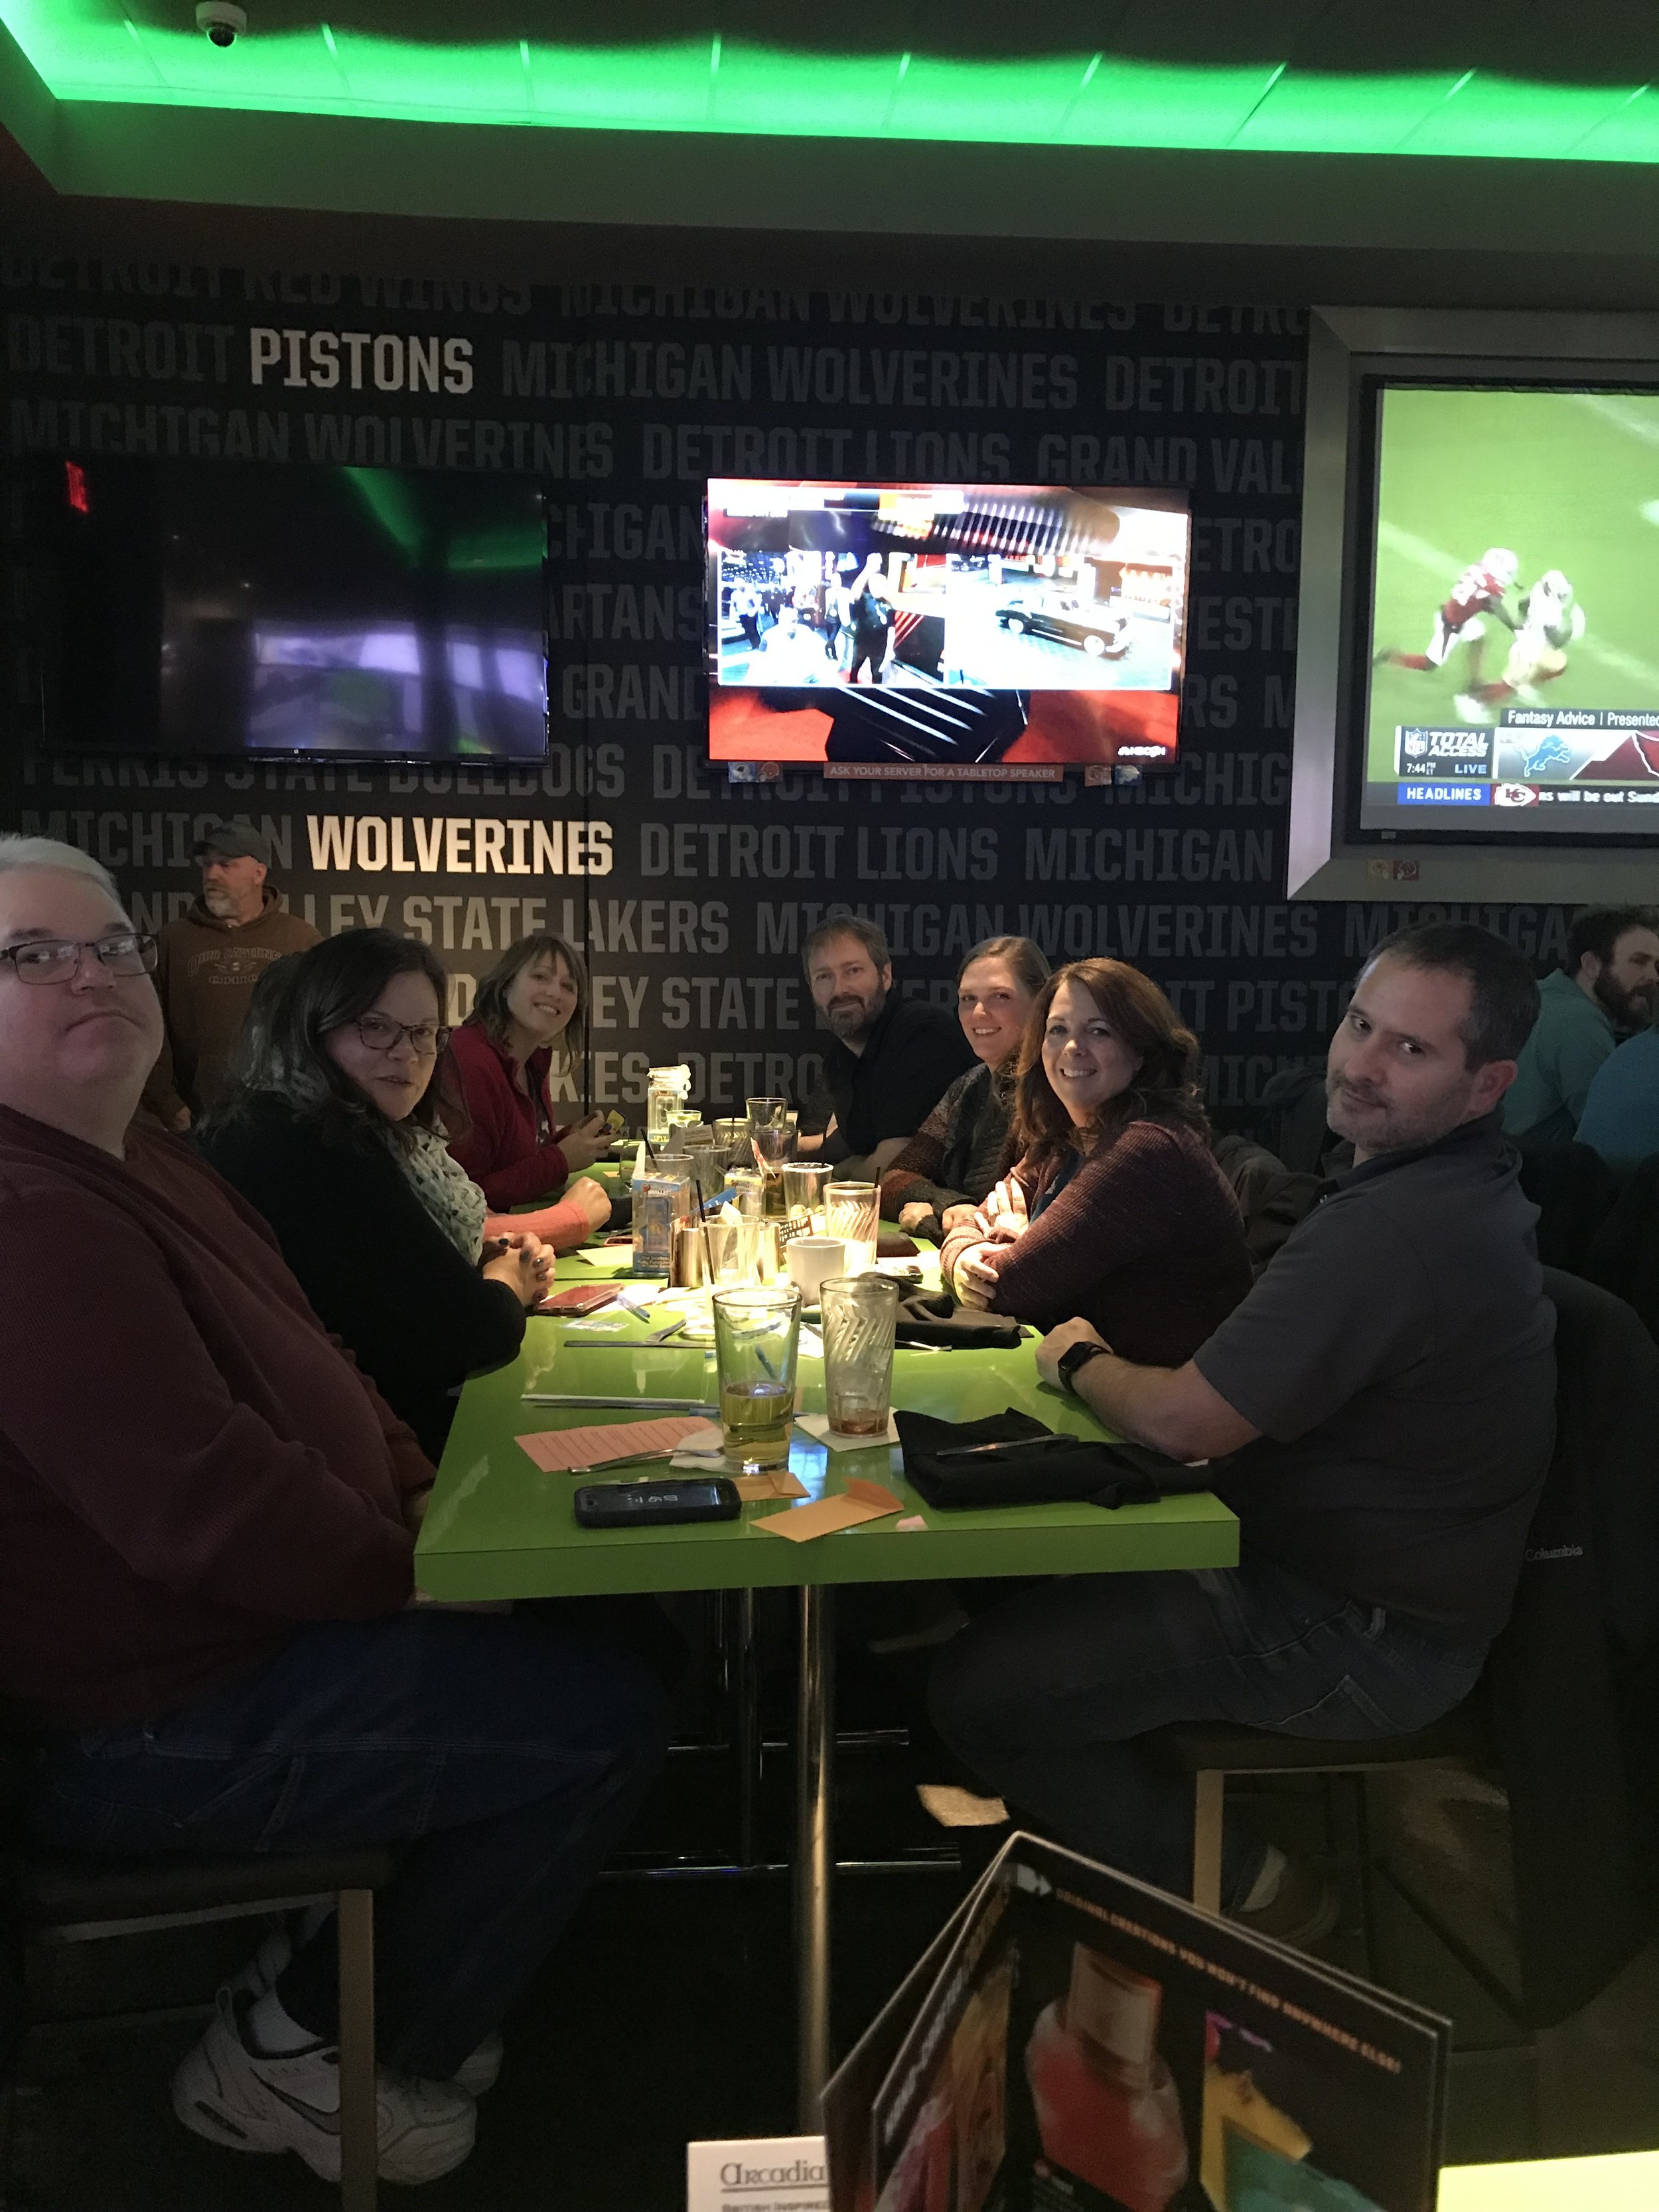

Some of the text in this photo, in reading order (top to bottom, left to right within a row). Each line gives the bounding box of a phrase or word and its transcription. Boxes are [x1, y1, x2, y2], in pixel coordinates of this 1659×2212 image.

[7, 311, 235, 384] DETROIT
[249, 327, 474, 395] PISTONS
[502, 339, 753, 400] MICHIGAN
[766, 345, 1080, 411] WOLVERINES
[11, 400, 289, 462] MICHIGAN
[304, 413, 614, 479] WOLVERINES
[642, 423, 853, 480] DETROIT
[865, 428, 1011, 479] LIONS
[1037, 432, 1196, 483] GRAND
[1508, 709, 1554, 727] Fantasy
[1556, 711, 1595, 725] Advice
[1429, 731, 1489, 747] TOTAL
[1427, 744, 1487, 757] ACCESS
[830, 764, 1055, 779] ASK YOUR SERVER FOR A TABLETOP SPEAKER
[1406, 763, 1426, 774] 7:44
[1455, 764, 1487, 774] LIVE
[1406, 786, 1482, 801] HEADLINES
[305, 814, 614, 876] WOLVERINES
[640, 822, 845, 879] DETROIT
[857, 826, 999, 881] LIONS
[1025, 827, 1273, 883] MICHIGAN
[561, 897, 730, 954] LAKERS
[1018, 903, 1318, 958] WOLVERINES
[662, 976, 800, 1031] STATE
[1526, 1544, 1584, 1561] Columbia
[719, 2159, 826, 2186] Arcadia
